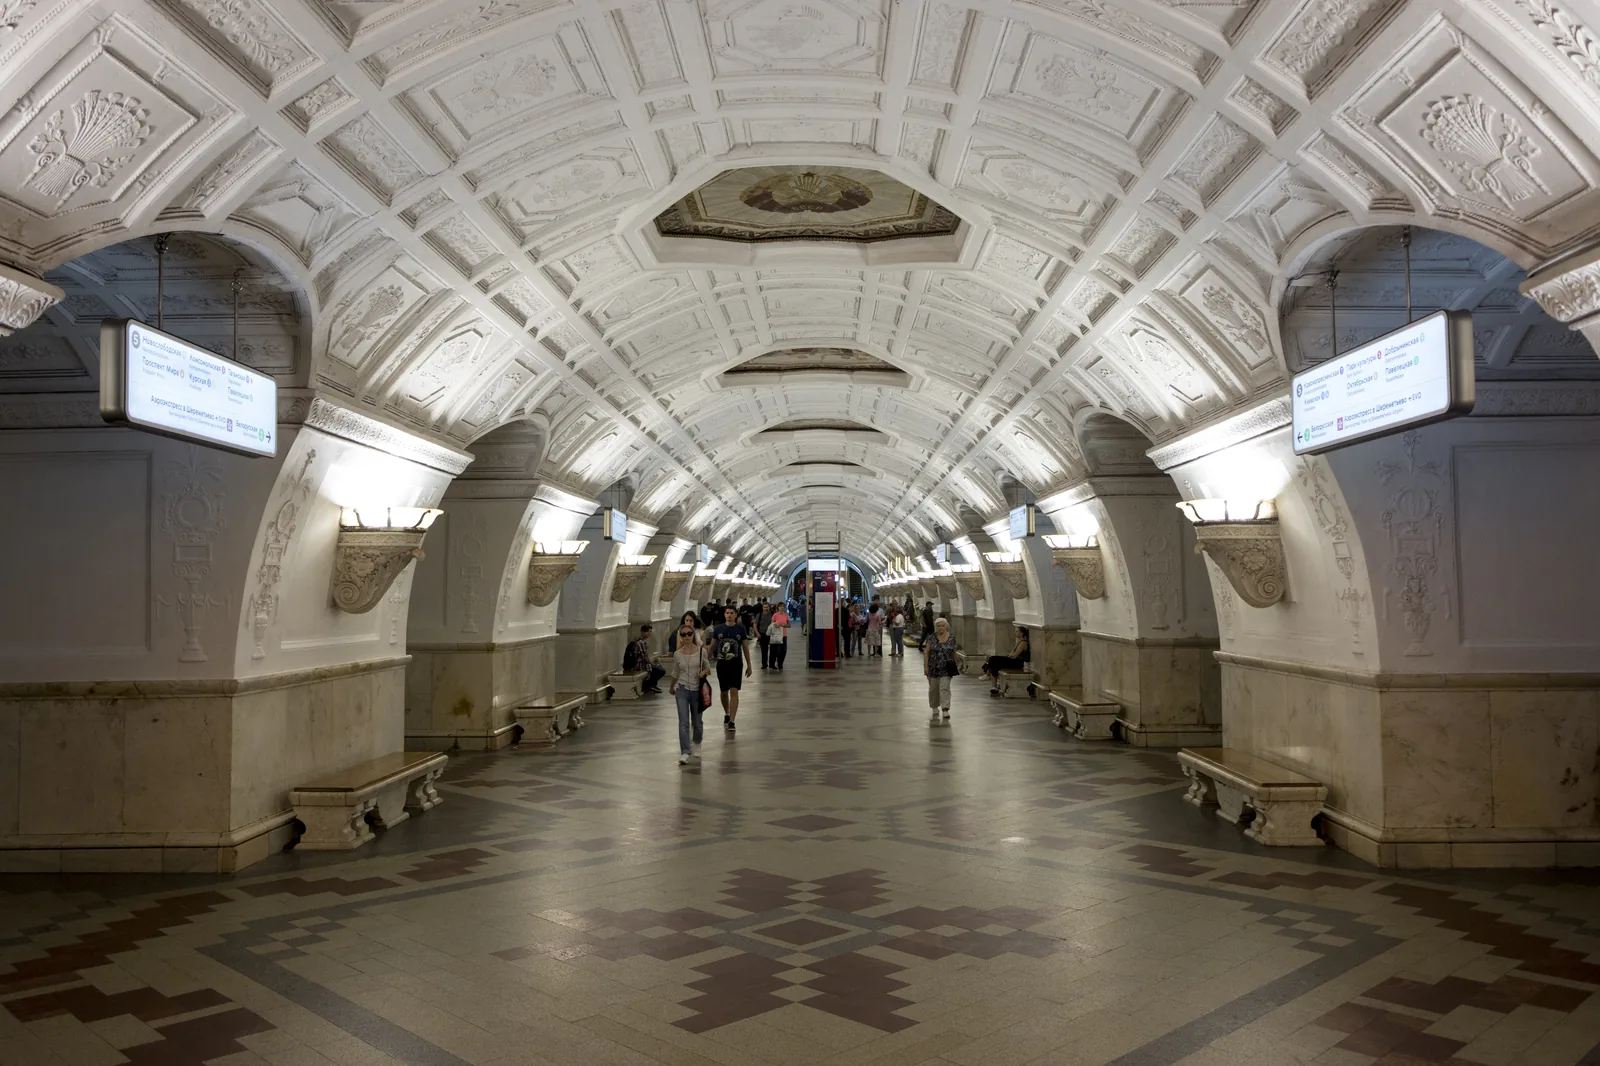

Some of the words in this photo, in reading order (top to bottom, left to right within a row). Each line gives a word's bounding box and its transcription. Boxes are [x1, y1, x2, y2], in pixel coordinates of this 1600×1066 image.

[142, 335, 182, 356] Новослободская
[1384, 337, 1419, 356] Добрынинская
[142, 356, 166, 370] Проспект
[166, 365, 179, 376] Мира
[189, 355, 221, 372] Комсомольская
[1346, 363, 1357, 372] Парк
[1385, 360, 1412, 376] Павелецкая
[188, 372, 206, 385] Курская
[1347, 375, 1373, 389] Октябрьская
[1311, 420, 1334, 433] Белорусская
